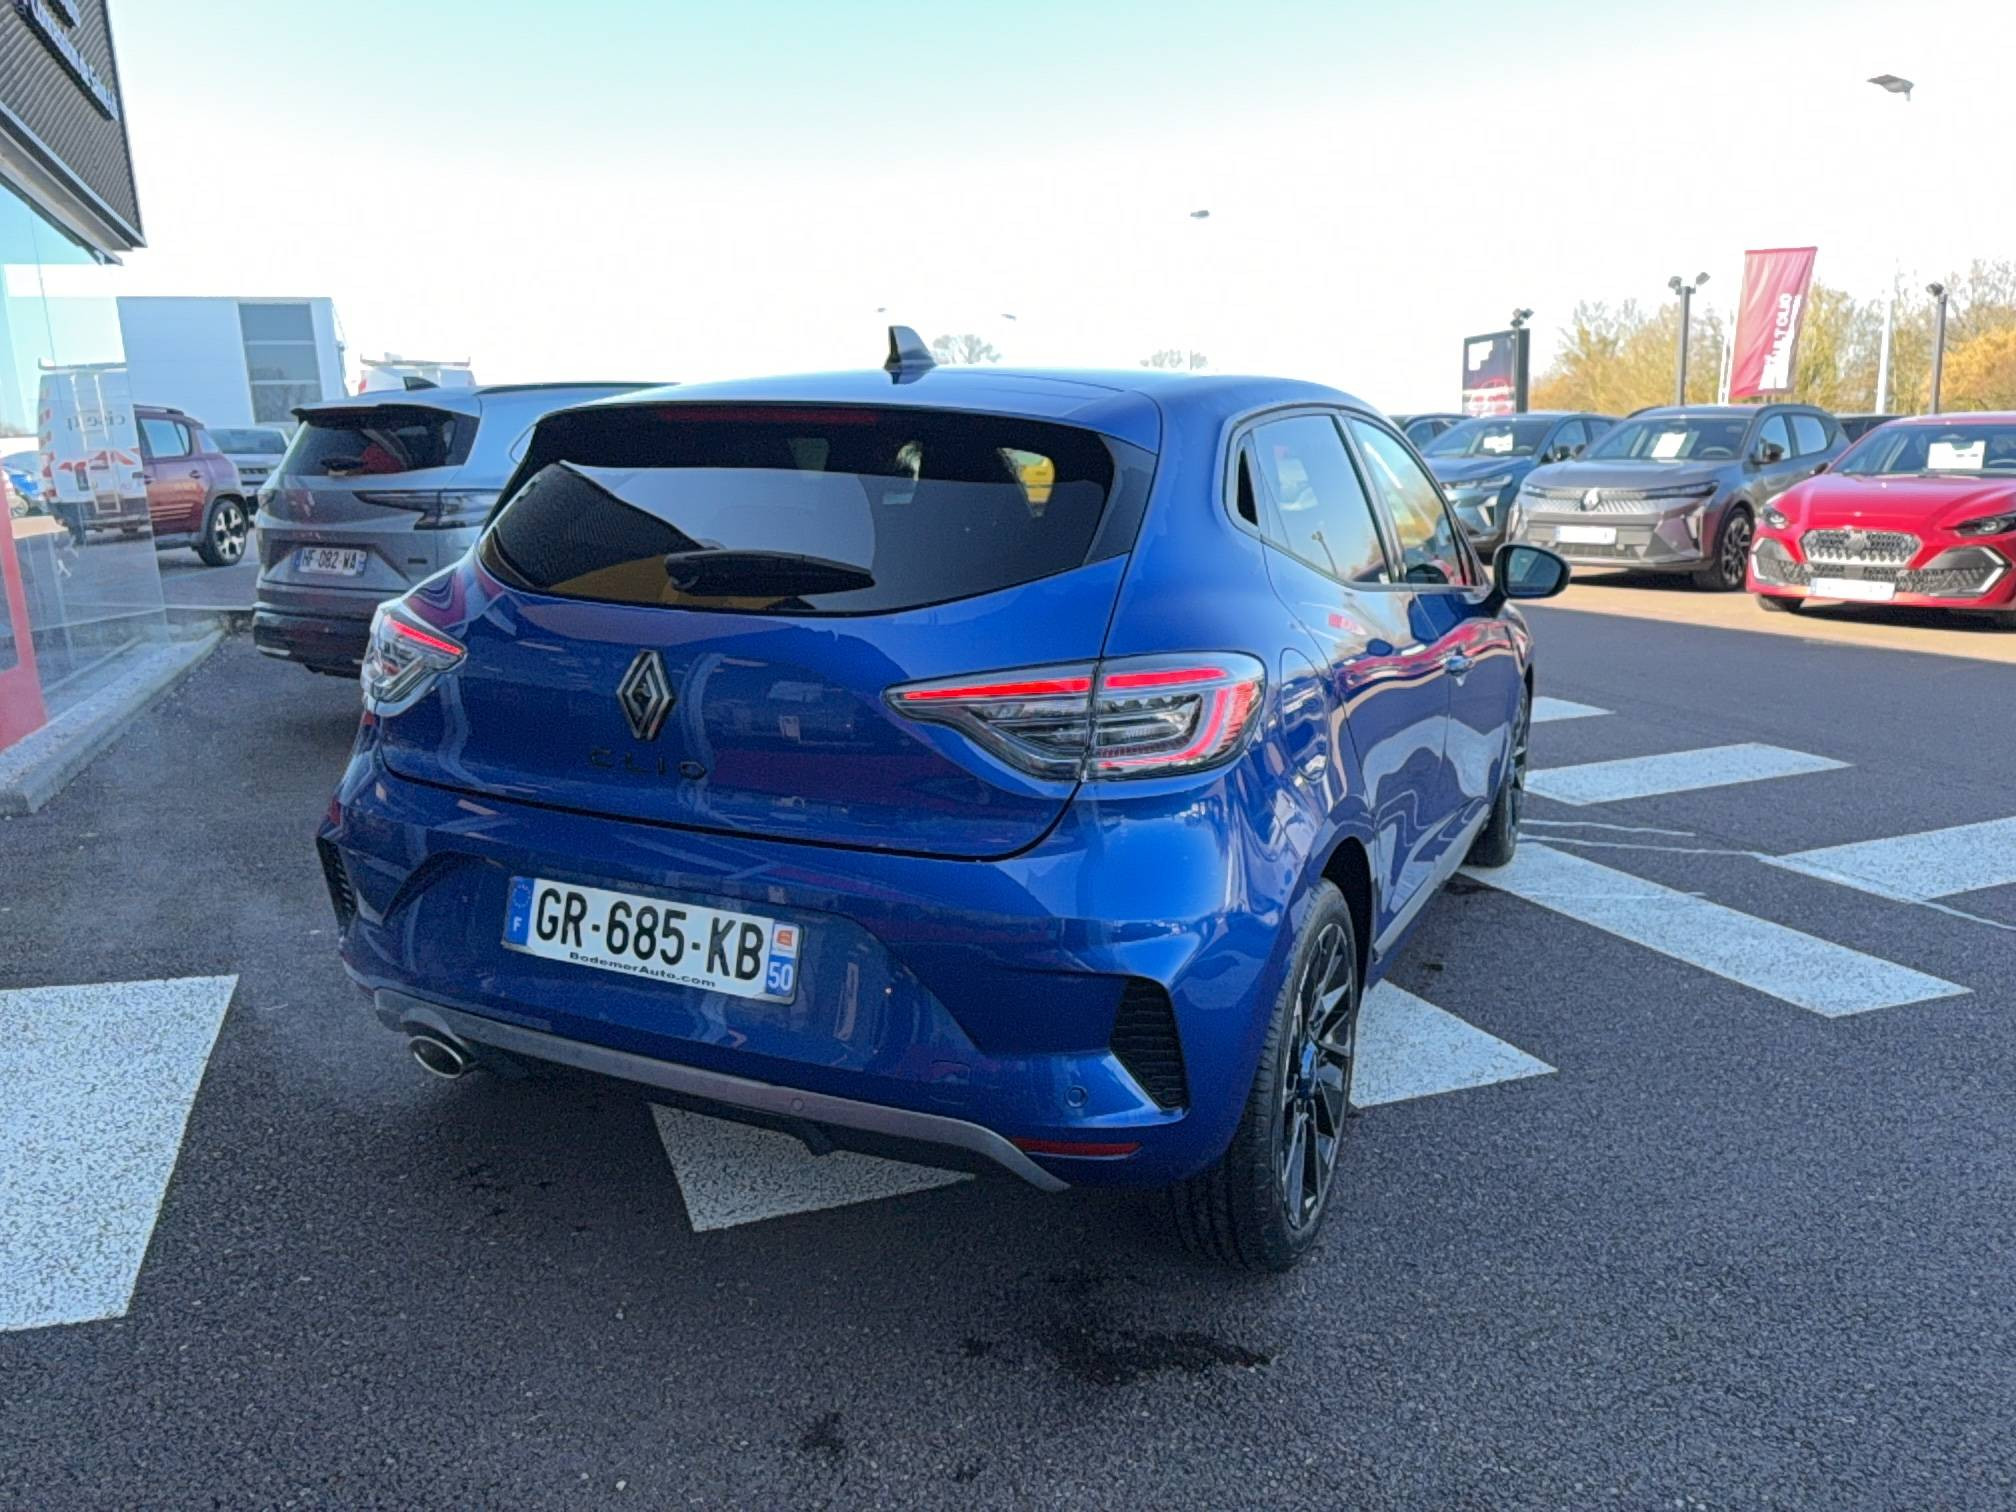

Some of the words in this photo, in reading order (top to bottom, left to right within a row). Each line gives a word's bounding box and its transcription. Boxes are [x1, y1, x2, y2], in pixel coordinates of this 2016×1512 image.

[590, 747, 707, 780] CLIO
[513, 916, 523, 931] F
[535, 887, 764, 981] GR-685-KB
[767, 961, 794, 991] 50
